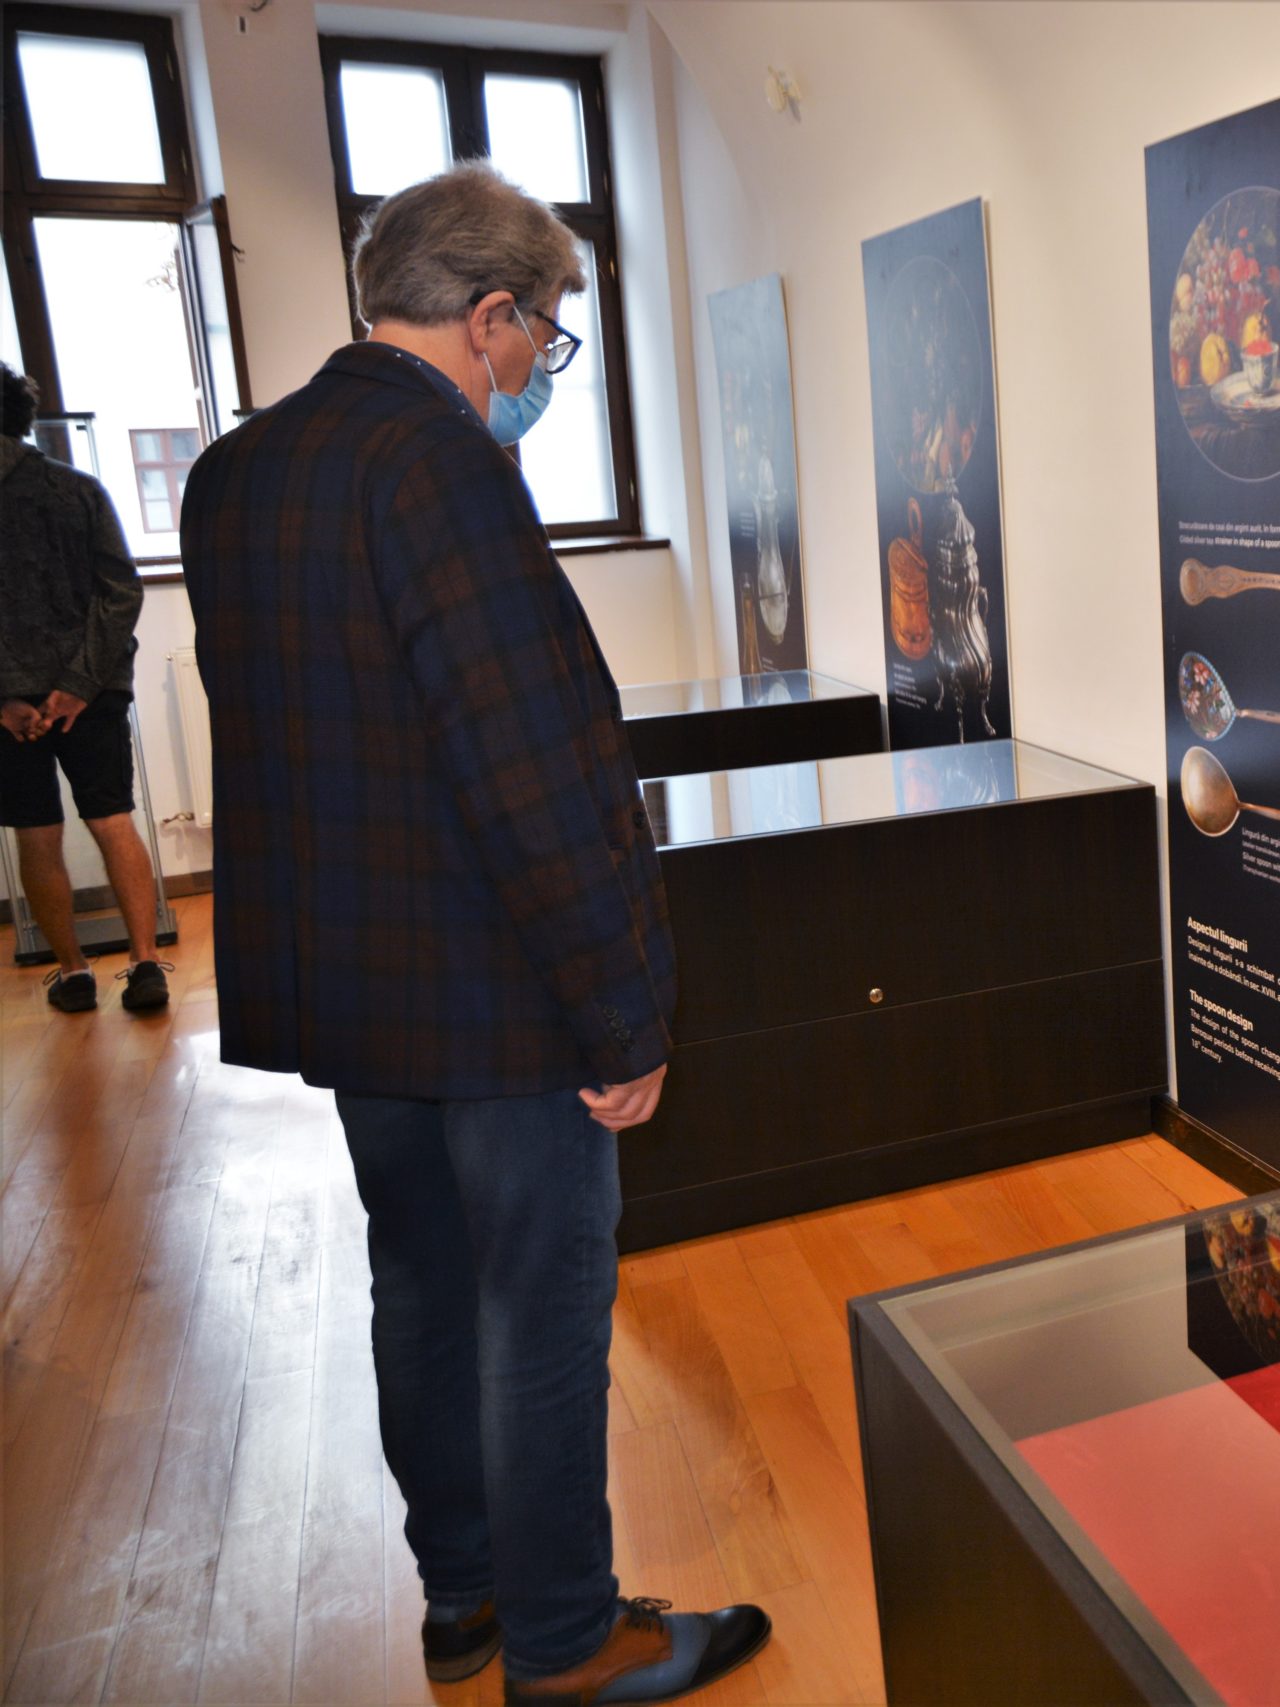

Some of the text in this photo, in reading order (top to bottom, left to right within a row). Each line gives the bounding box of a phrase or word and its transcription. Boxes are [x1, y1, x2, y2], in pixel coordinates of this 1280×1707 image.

[1188, 916, 1248, 953] Aspectul lingurii
[1246, 964, 1275, 983] schimbat
[1190, 988, 1253, 1032] The spoon design
[1241, 1037, 1260, 1052] spoon
